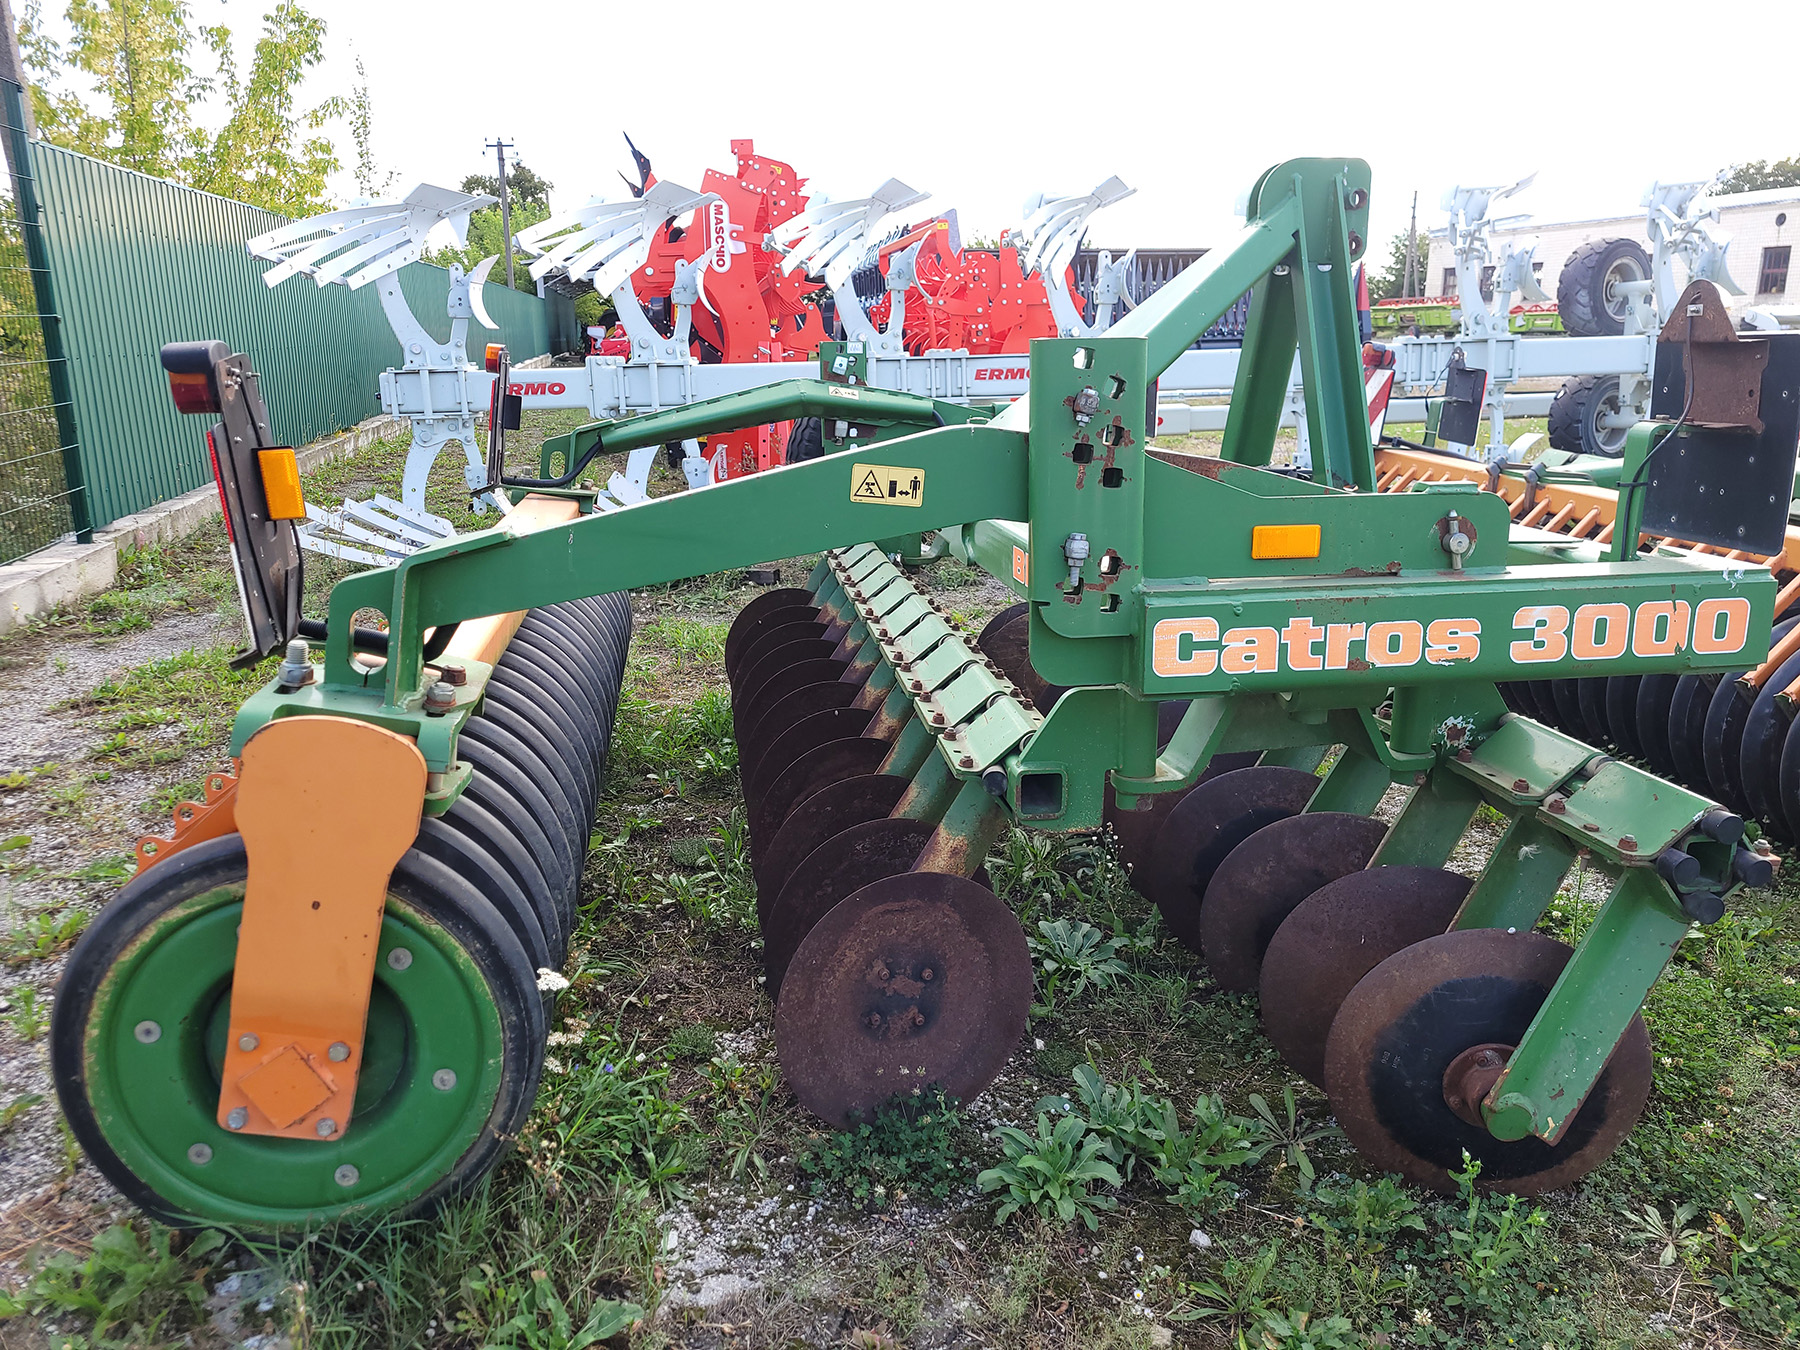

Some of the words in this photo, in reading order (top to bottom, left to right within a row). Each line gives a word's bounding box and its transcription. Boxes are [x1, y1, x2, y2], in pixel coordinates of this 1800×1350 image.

[713, 204, 726, 268] MASCHIO
[509, 382, 566, 396] RMO
[1152, 616, 1482, 678] Catros
[1509, 597, 1751, 664] 3000
